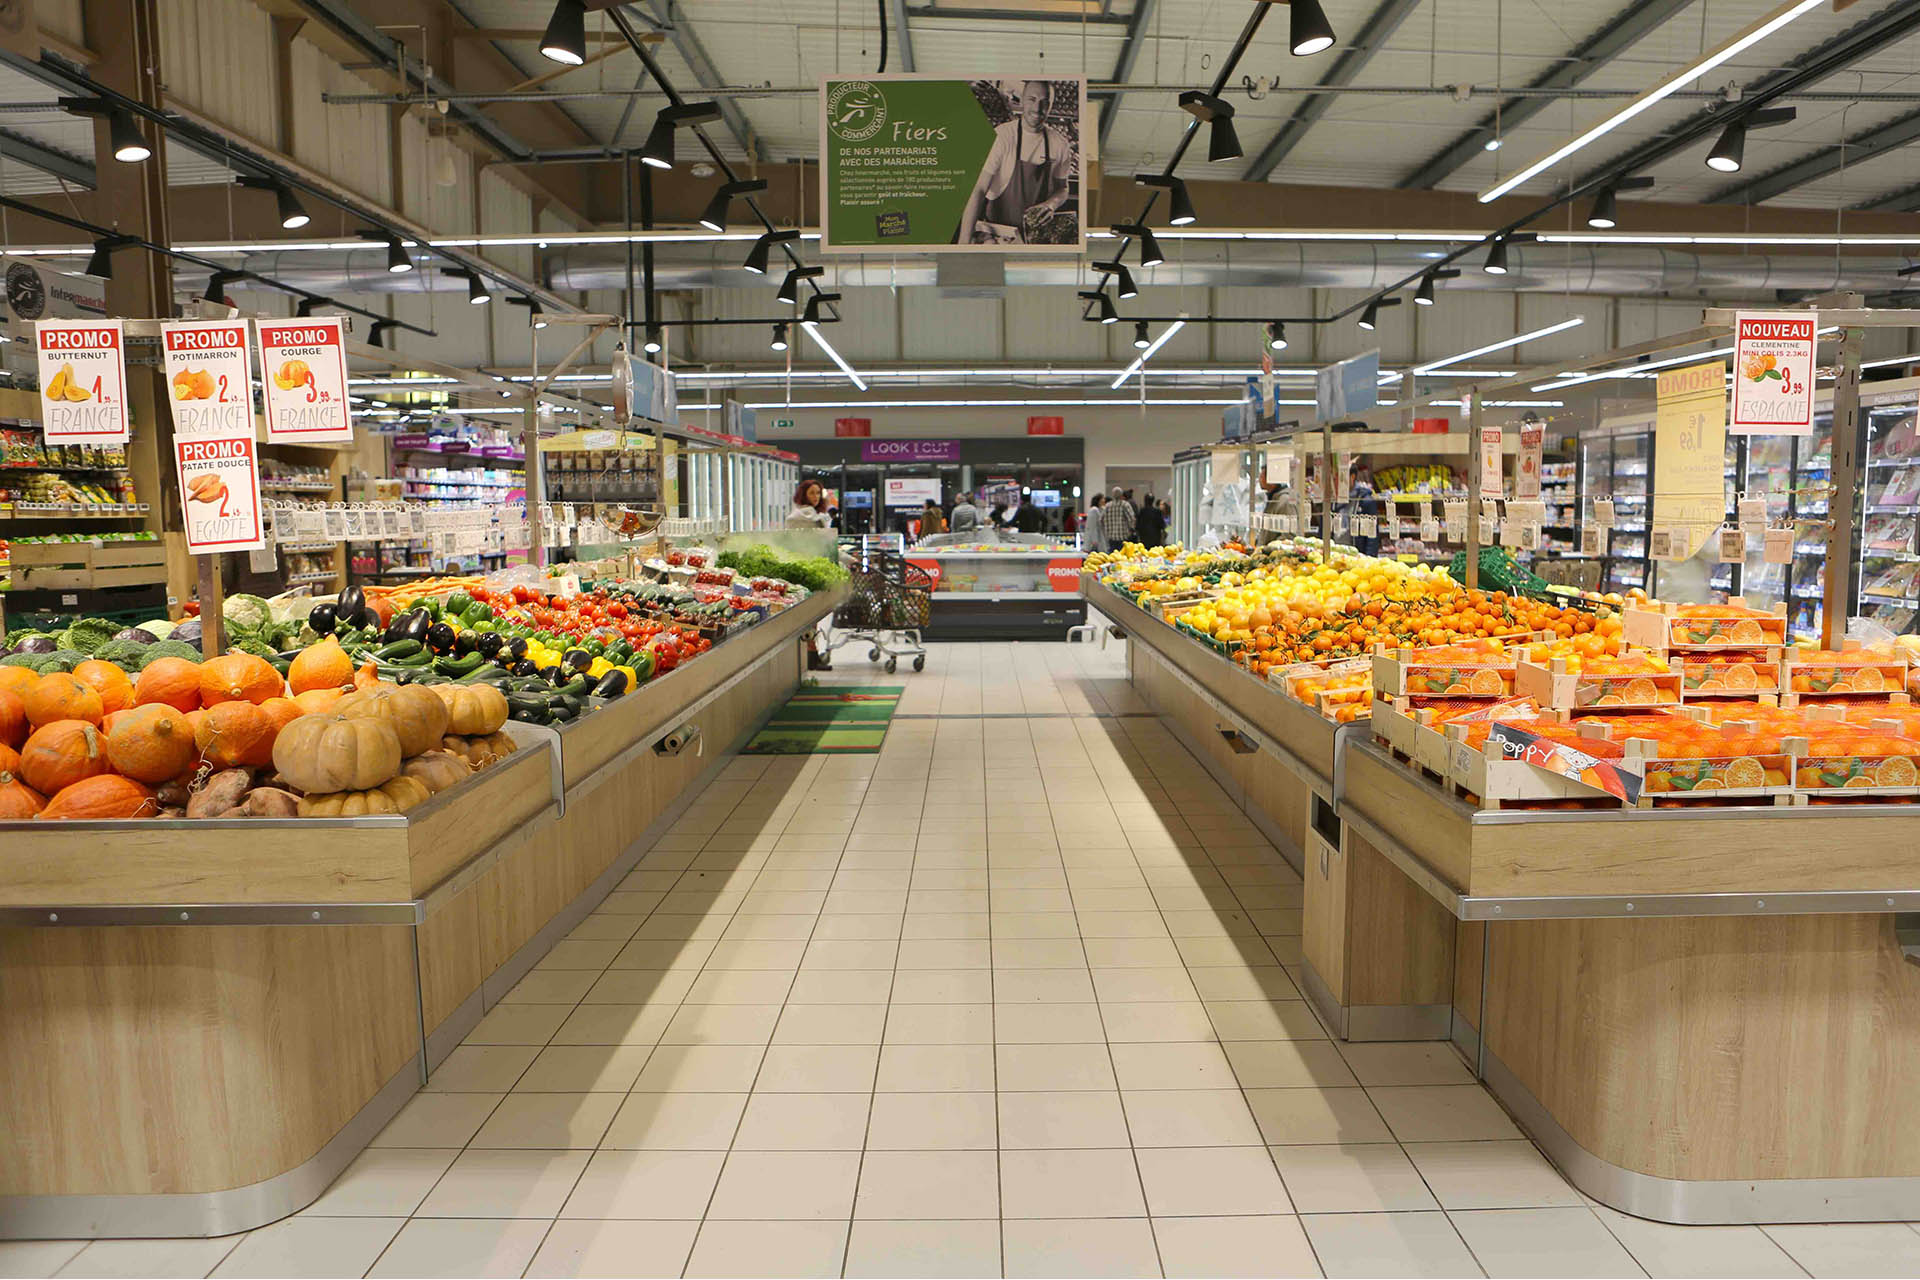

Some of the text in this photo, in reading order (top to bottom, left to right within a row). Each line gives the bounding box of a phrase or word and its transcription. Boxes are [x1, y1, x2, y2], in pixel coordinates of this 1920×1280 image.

[828, 82, 870, 115] PRODUCTEUR
[893, 121, 948, 142] Fiers
[840, 147, 937, 156] DE NOS PARTENARIATS
[840, 158, 862, 166] AVEC
[864, 158, 880, 166] DES
[50, 286, 106, 309] Intermarch
[272, 329, 328, 345] PROMO
[1742, 323, 1810, 337] NOUVEAU
[46, 331, 112, 348] PROMO
[172, 330, 238, 349] PROMO
[1751, 341, 1800, 349] CLEMENTINE
[48, 352, 108, 360] BUTTERNUT
[172, 351, 238, 361] POTIMARRON
[281, 347, 322, 356] COURGE
[51, 406, 119, 432] FRANCE
[180, 405, 245, 433] FRANCE
[280, 406, 338, 430] FRANCE
[1741, 400, 1806, 421] ESPAGNE
[183, 440, 246, 460] PROMO
[870, 443, 910, 453] LOOK
[182, 459, 251, 471] PATATE DOUCE
[196, 518, 248, 542] EGYPTE
